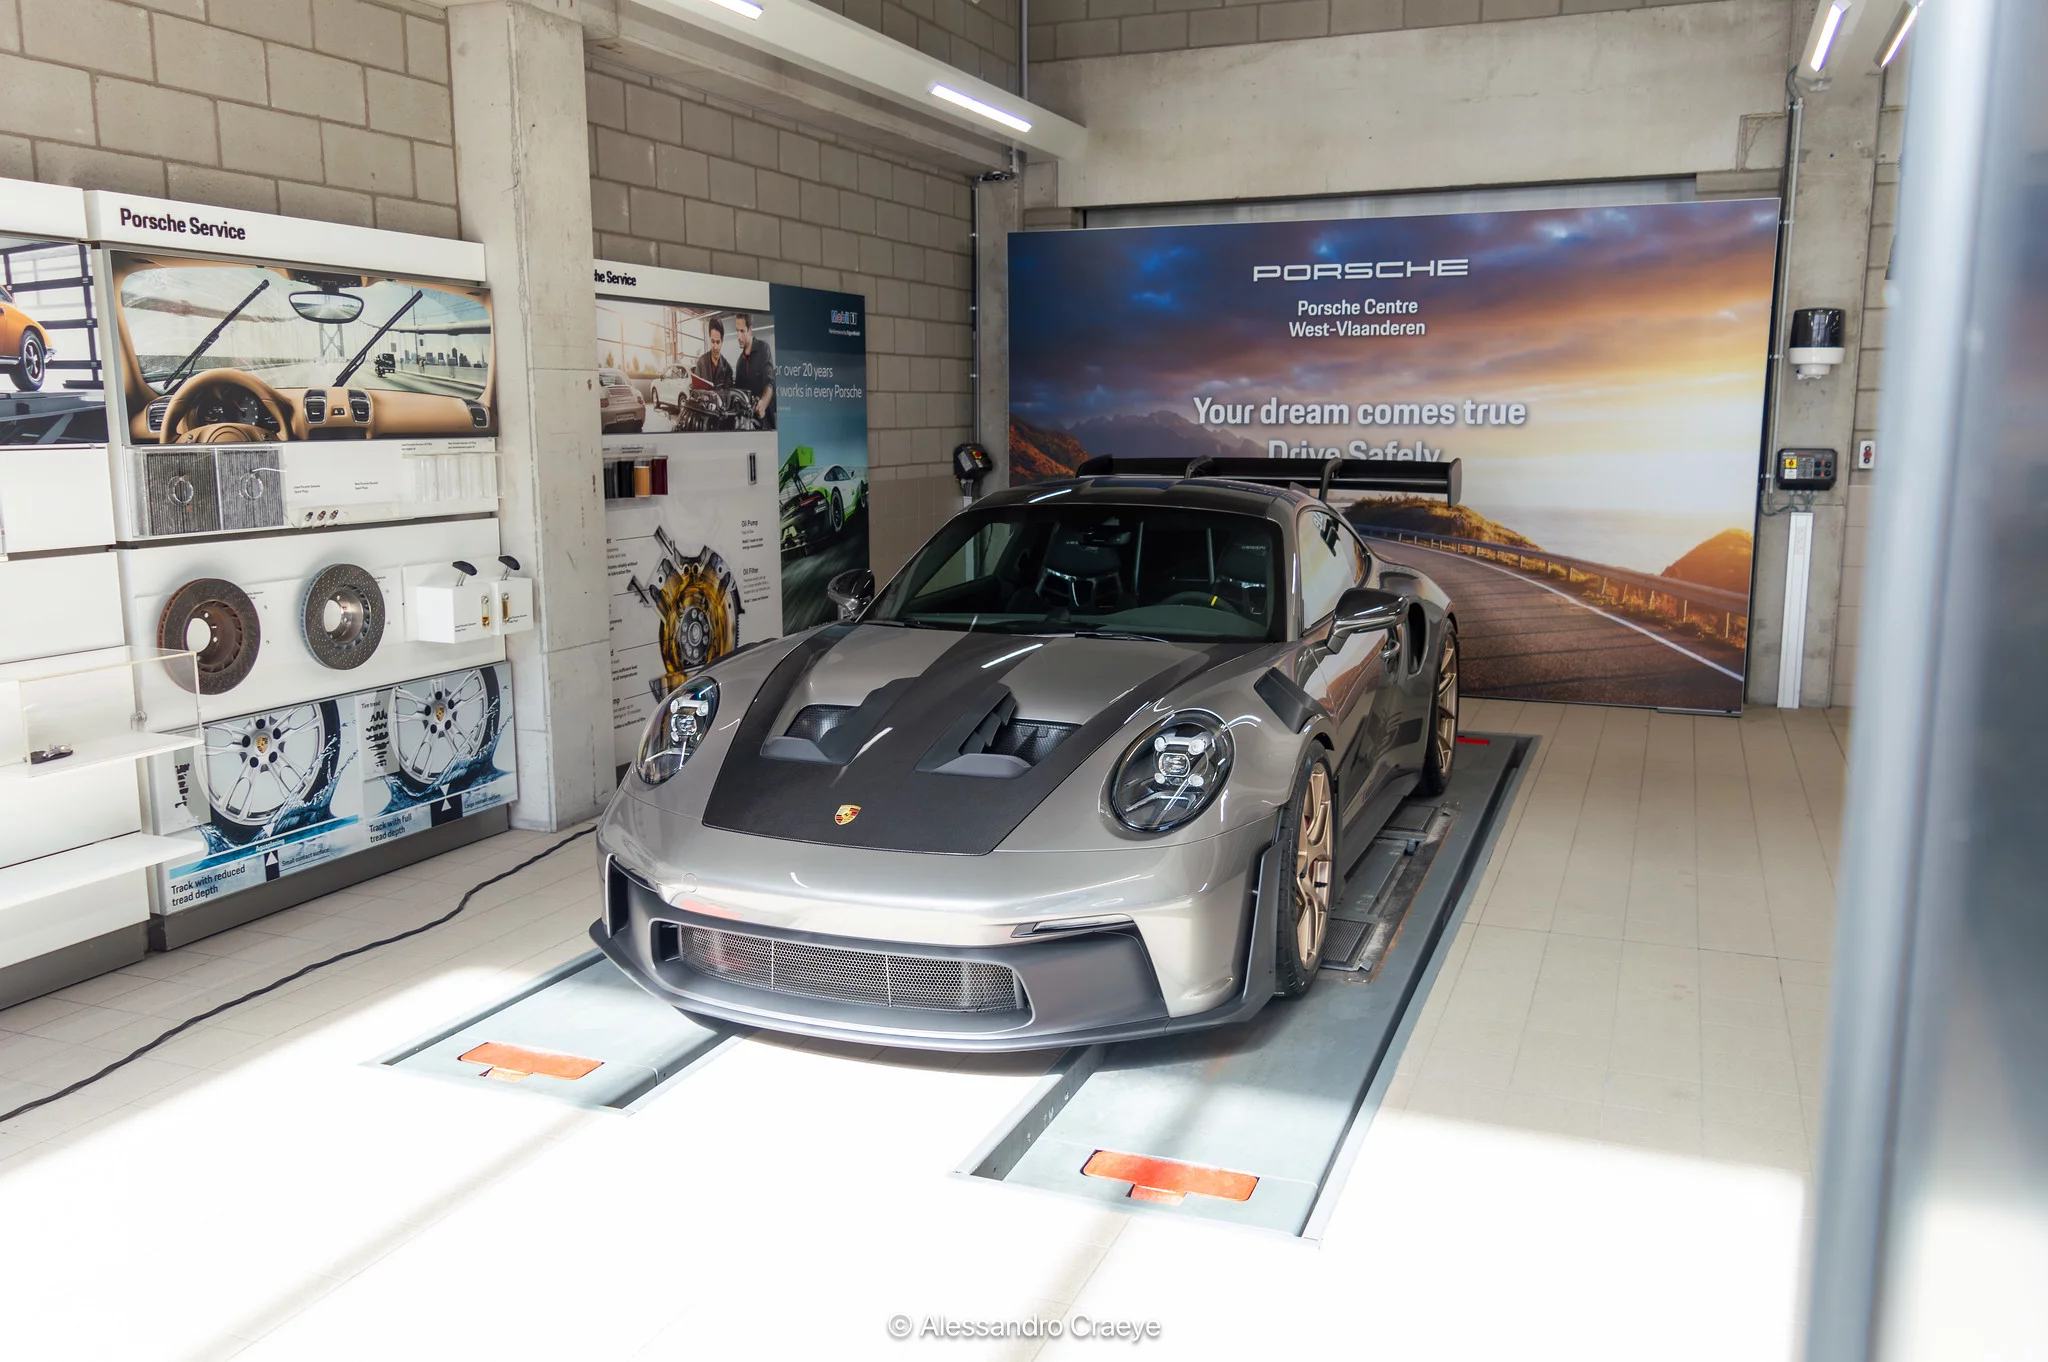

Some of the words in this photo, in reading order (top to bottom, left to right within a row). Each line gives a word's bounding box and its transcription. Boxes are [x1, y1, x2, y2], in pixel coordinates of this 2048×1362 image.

[120, 207, 187, 233] Porsche
[189, 216, 246, 240] Service
[594, 269, 606, 283] he
[606, 270, 637, 286] Service
[1253, 258, 1469, 282] PORSCHE
[1297, 299, 1361, 316] Porsche
[1364, 298, 1418, 315] Centre
[1288, 320, 1426, 337] West-Vlaanderen
[784, 364, 801, 376] over
[803, 363, 813, 377] 20
[814, 367, 833, 381] years
[781, 383, 804, 397] works
[805, 384, 812, 397] in
[813, 386, 834, 402] every
[835, 384, 862, 398] Porsche
[1193, 397, 1254, 425] Your
[1260, 397, 1350, 425] dream
[1356, 402, 1456, 425] comes
[1463, 399, 1526, 425] true
[1268, 440, 1342, 459] Drive
[1349, 440, 1440, 463] Safely
[369, 820, 386, 833] Track
[387, 816, 401, 827] with
[401, 813, 412, 823] full
[370, 831, 387, 843] tread
[387, 826, 406, 838] depth
[282, 857, 295, 867] Small
[171, 880, 194, 895] Track
[194, 875, 213, 888] with
[214, 864, 246, 882] reduced
[172, 892, 194, 906] tread
[195, 884, 219, 898] depth
